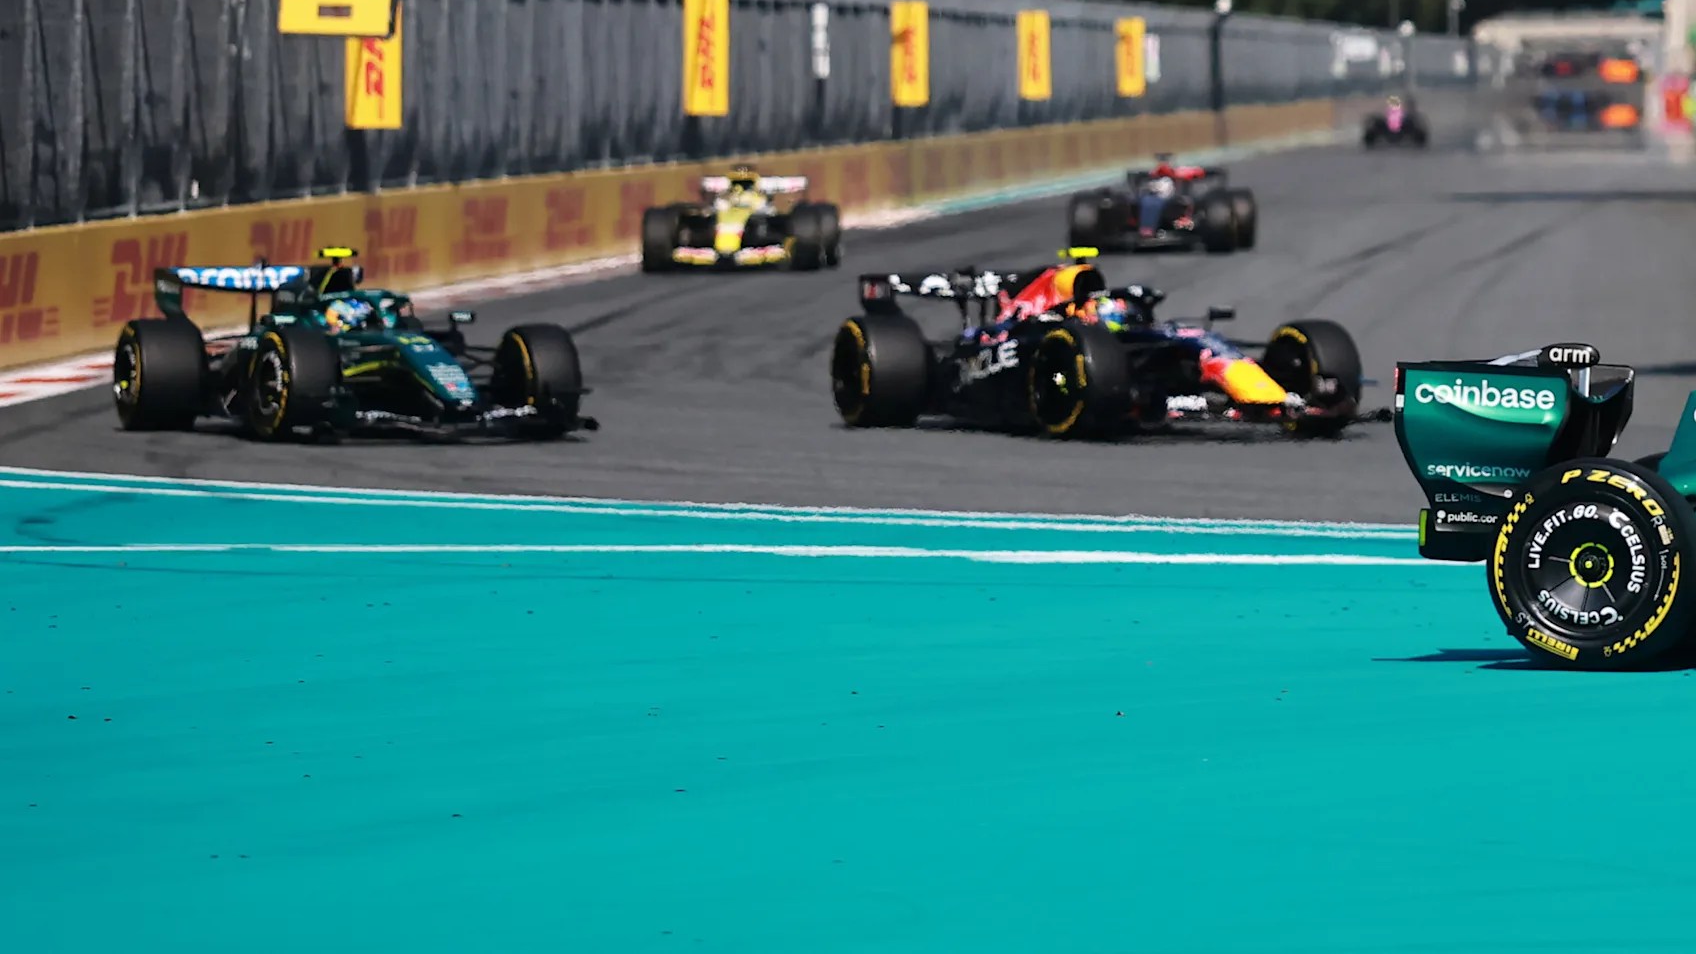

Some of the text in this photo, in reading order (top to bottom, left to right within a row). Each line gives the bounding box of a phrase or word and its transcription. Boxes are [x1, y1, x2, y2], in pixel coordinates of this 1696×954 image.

[362, 38, 384, 98] DH
[0, 252, 44, 344] HL
[1549, 347, 1590, 364] arm
[1414, 378, 1556, 410] coinbase
[1427, 462, 1531, 478] servicenow
[1434, 493, 1482, 503] ELEMIS
[1561, 469, 1665, 517] P ZERO
[1526, 628, 1579, 661] PIRELLI
